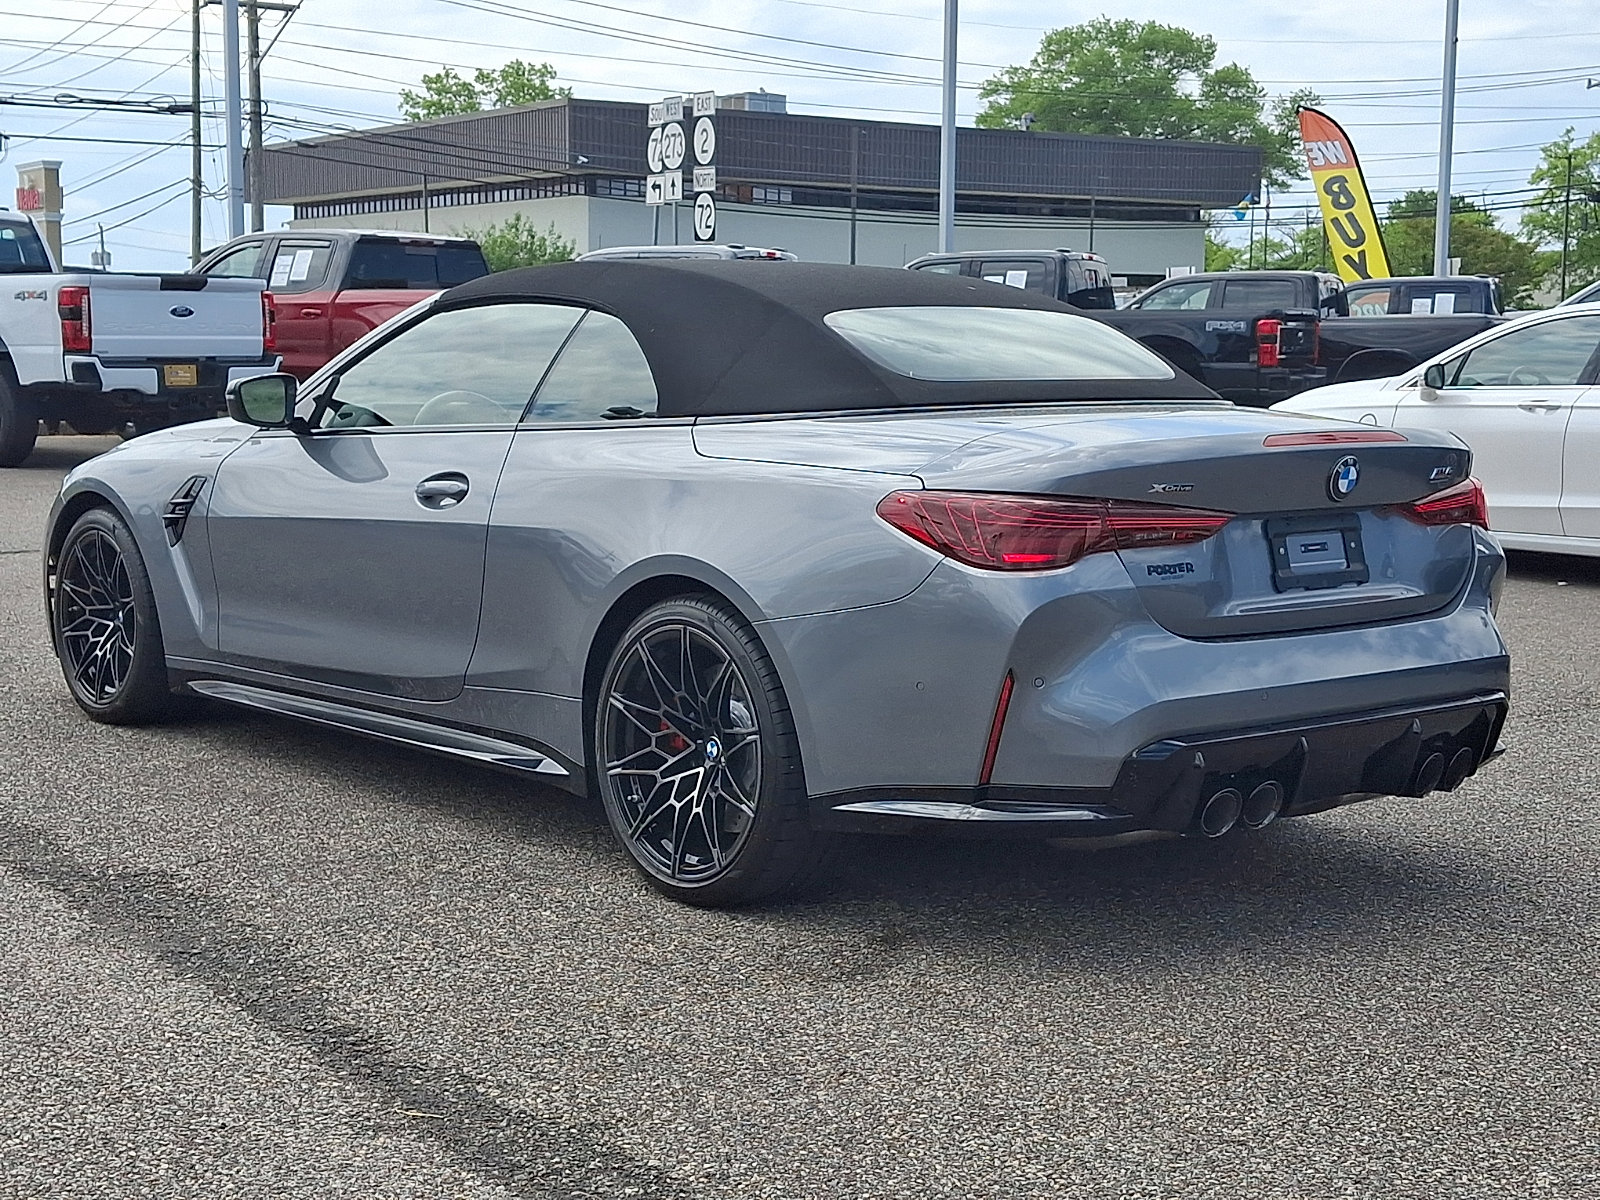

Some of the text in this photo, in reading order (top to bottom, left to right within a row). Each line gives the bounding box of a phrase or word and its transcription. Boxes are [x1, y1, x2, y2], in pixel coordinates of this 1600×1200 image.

[666, 102, 680, 117] WEST
[697, 97, 711, 112] EAST
[665, 133, 683, 158] 273
[701, 129, 709, 154] 2
[695, 172, 714, 188] NORTH
[697, 204, 713, 229] 72
[1146, 562, 1195, 576] PORTER
